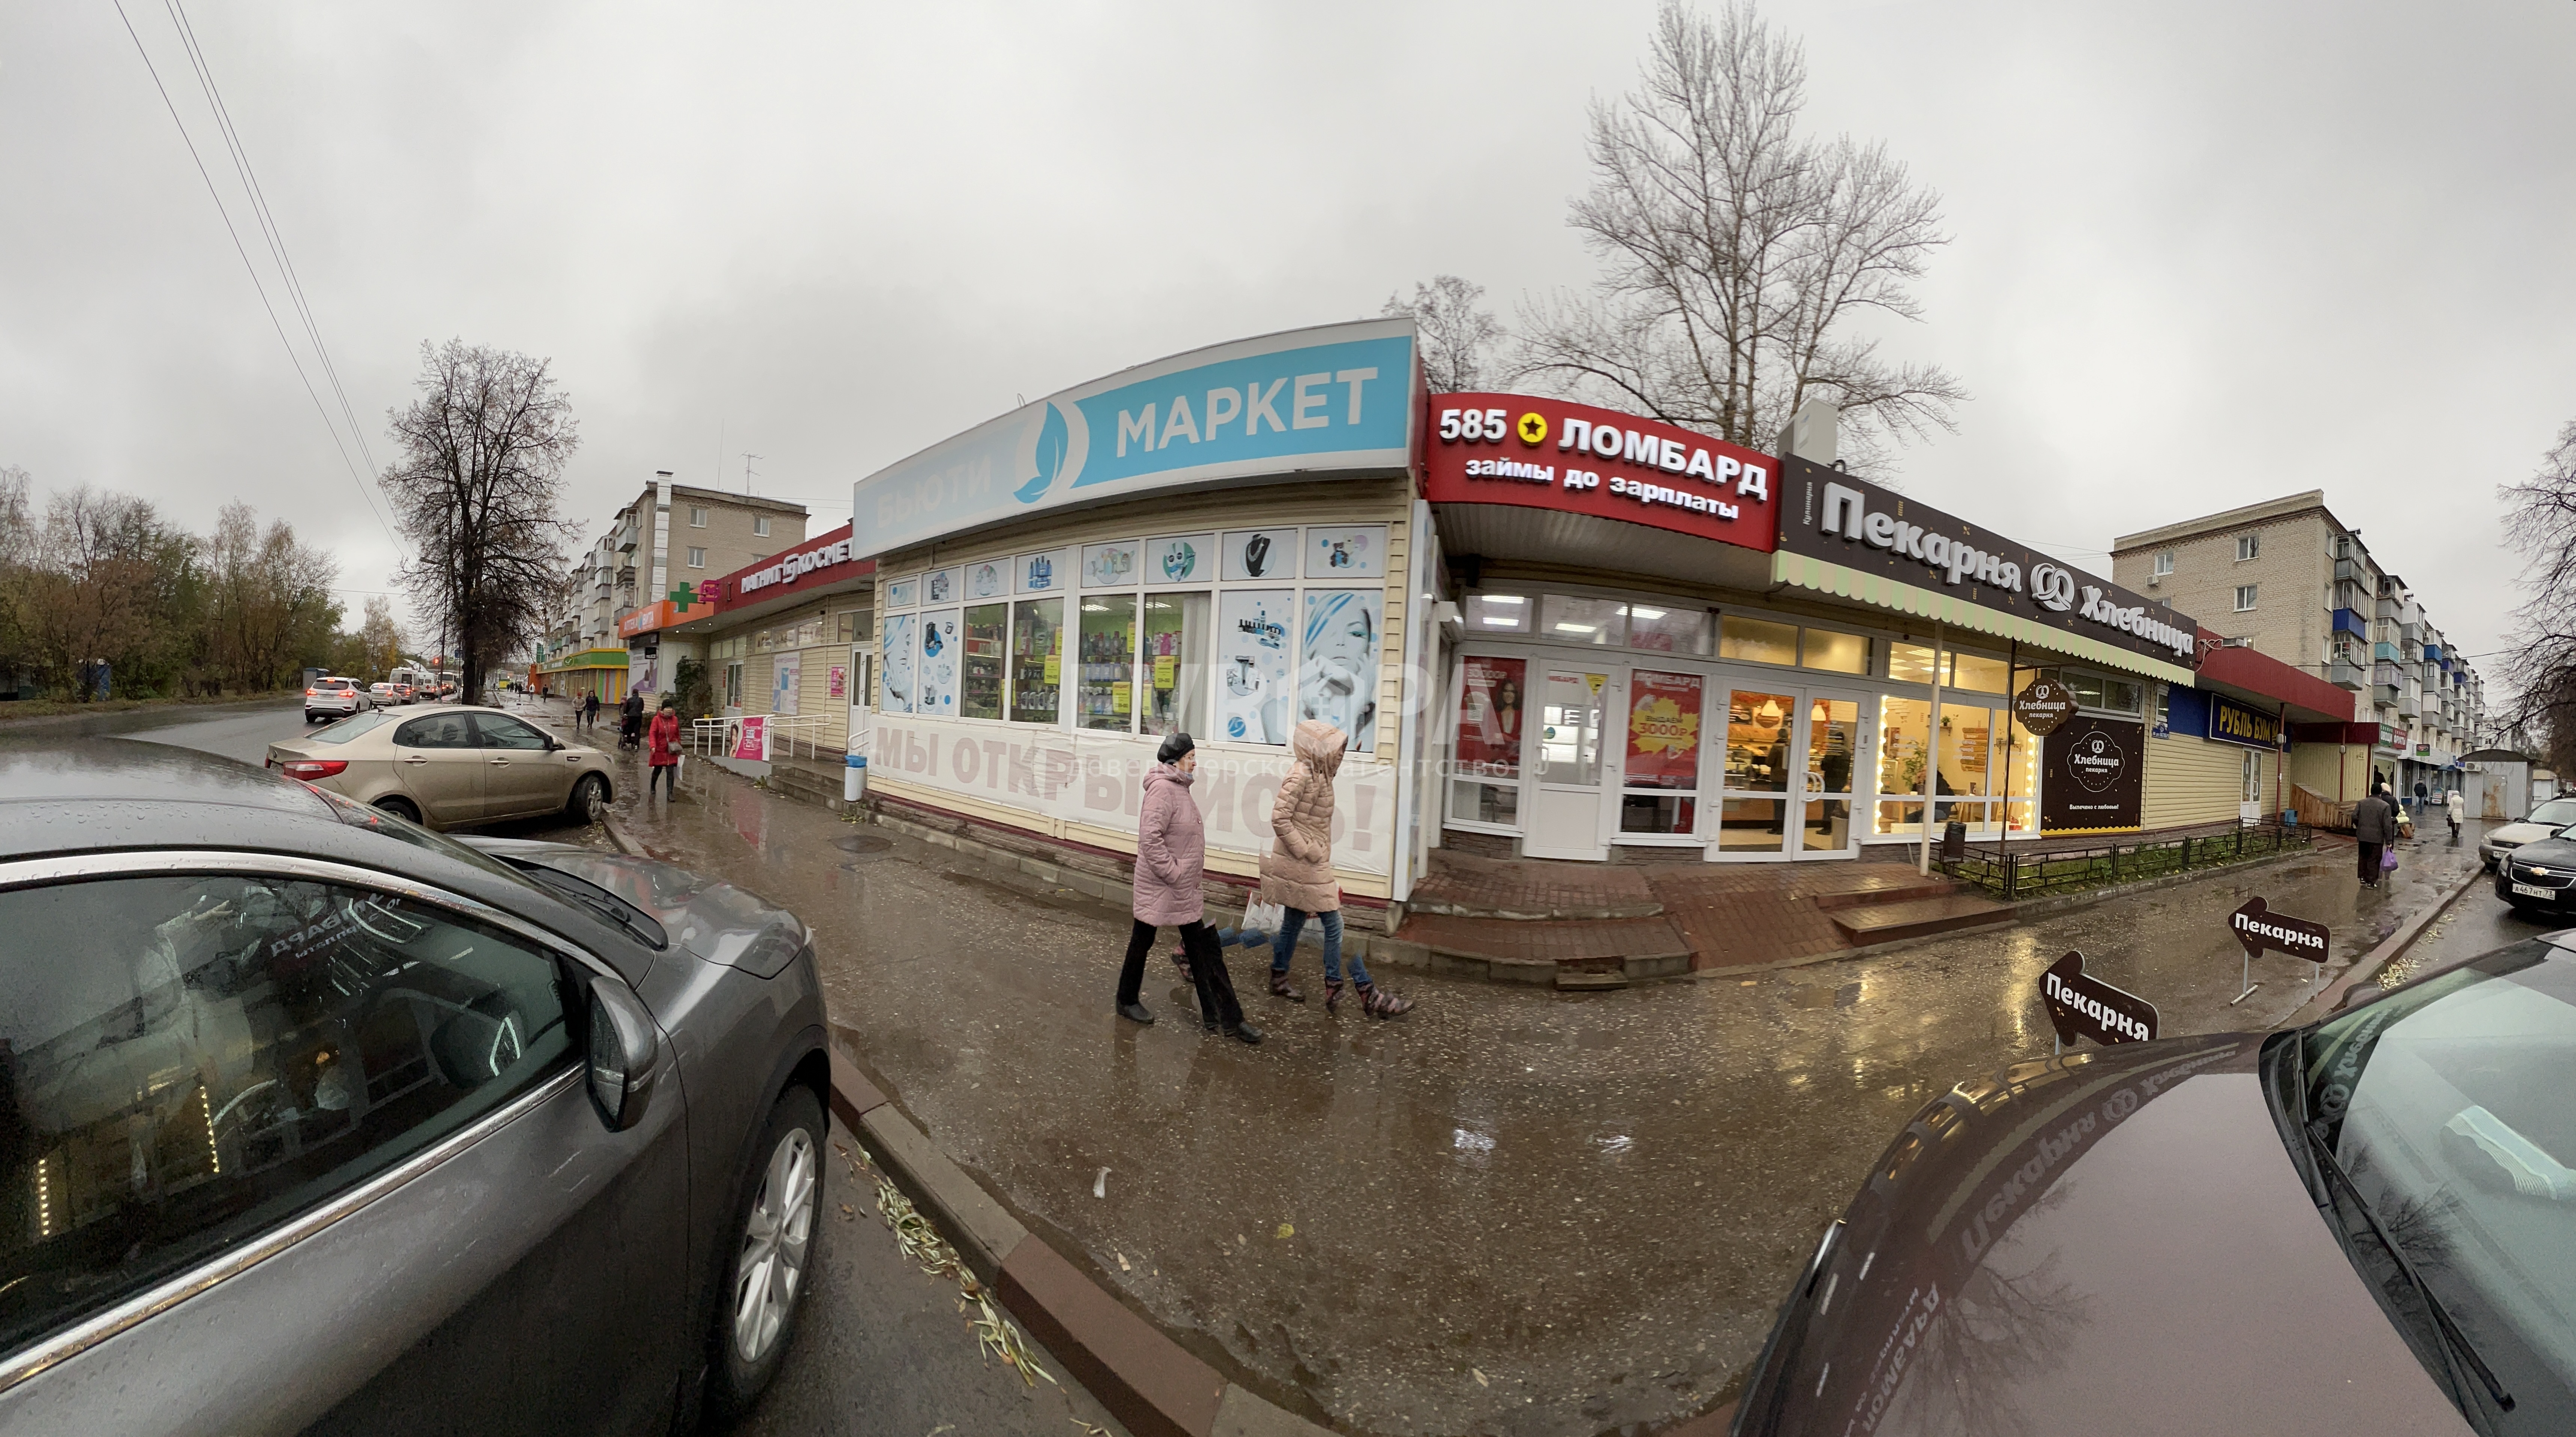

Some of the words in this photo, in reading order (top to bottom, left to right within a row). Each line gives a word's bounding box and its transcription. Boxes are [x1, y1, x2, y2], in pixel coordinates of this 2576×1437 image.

[878, 454, 992, 528] БЬЮТИ
[1116, 367, 1378, 458] МАРКЕТ
[1439, 409, 1507, 442] 585
[1558, 417, 1769, 502] ЛОМБАРД
[1465, 457, 1555, 484] займы
[1563, 468, 1600, 490] до
[1609, 476, 1739, 521] зарплаты
[1802, 481, 1814, 525] Кулинария
[741, 563, 784, 594] МАГНИТ
[1821, 482, 2022, 592] Пекарня
[2079, 586, 2194, 657] Хлебница
[643, 611, 654, 626] ВИТА
[2019, 700, 2066, 711] Хлебница
[2219, 705, 2252, 738] РУБЛЬ
[2254, 716, 2271, 742] БУМ
[2074, 753, 2119, 767] Хлебница
[875, 727, 939, 776] МЫ
[952, 737, 1377, 852] ОТКРЫИС!
[2234, 913, 2324, 950] Пекарня
[2046, 972, 2149, 1042] Пекарня
